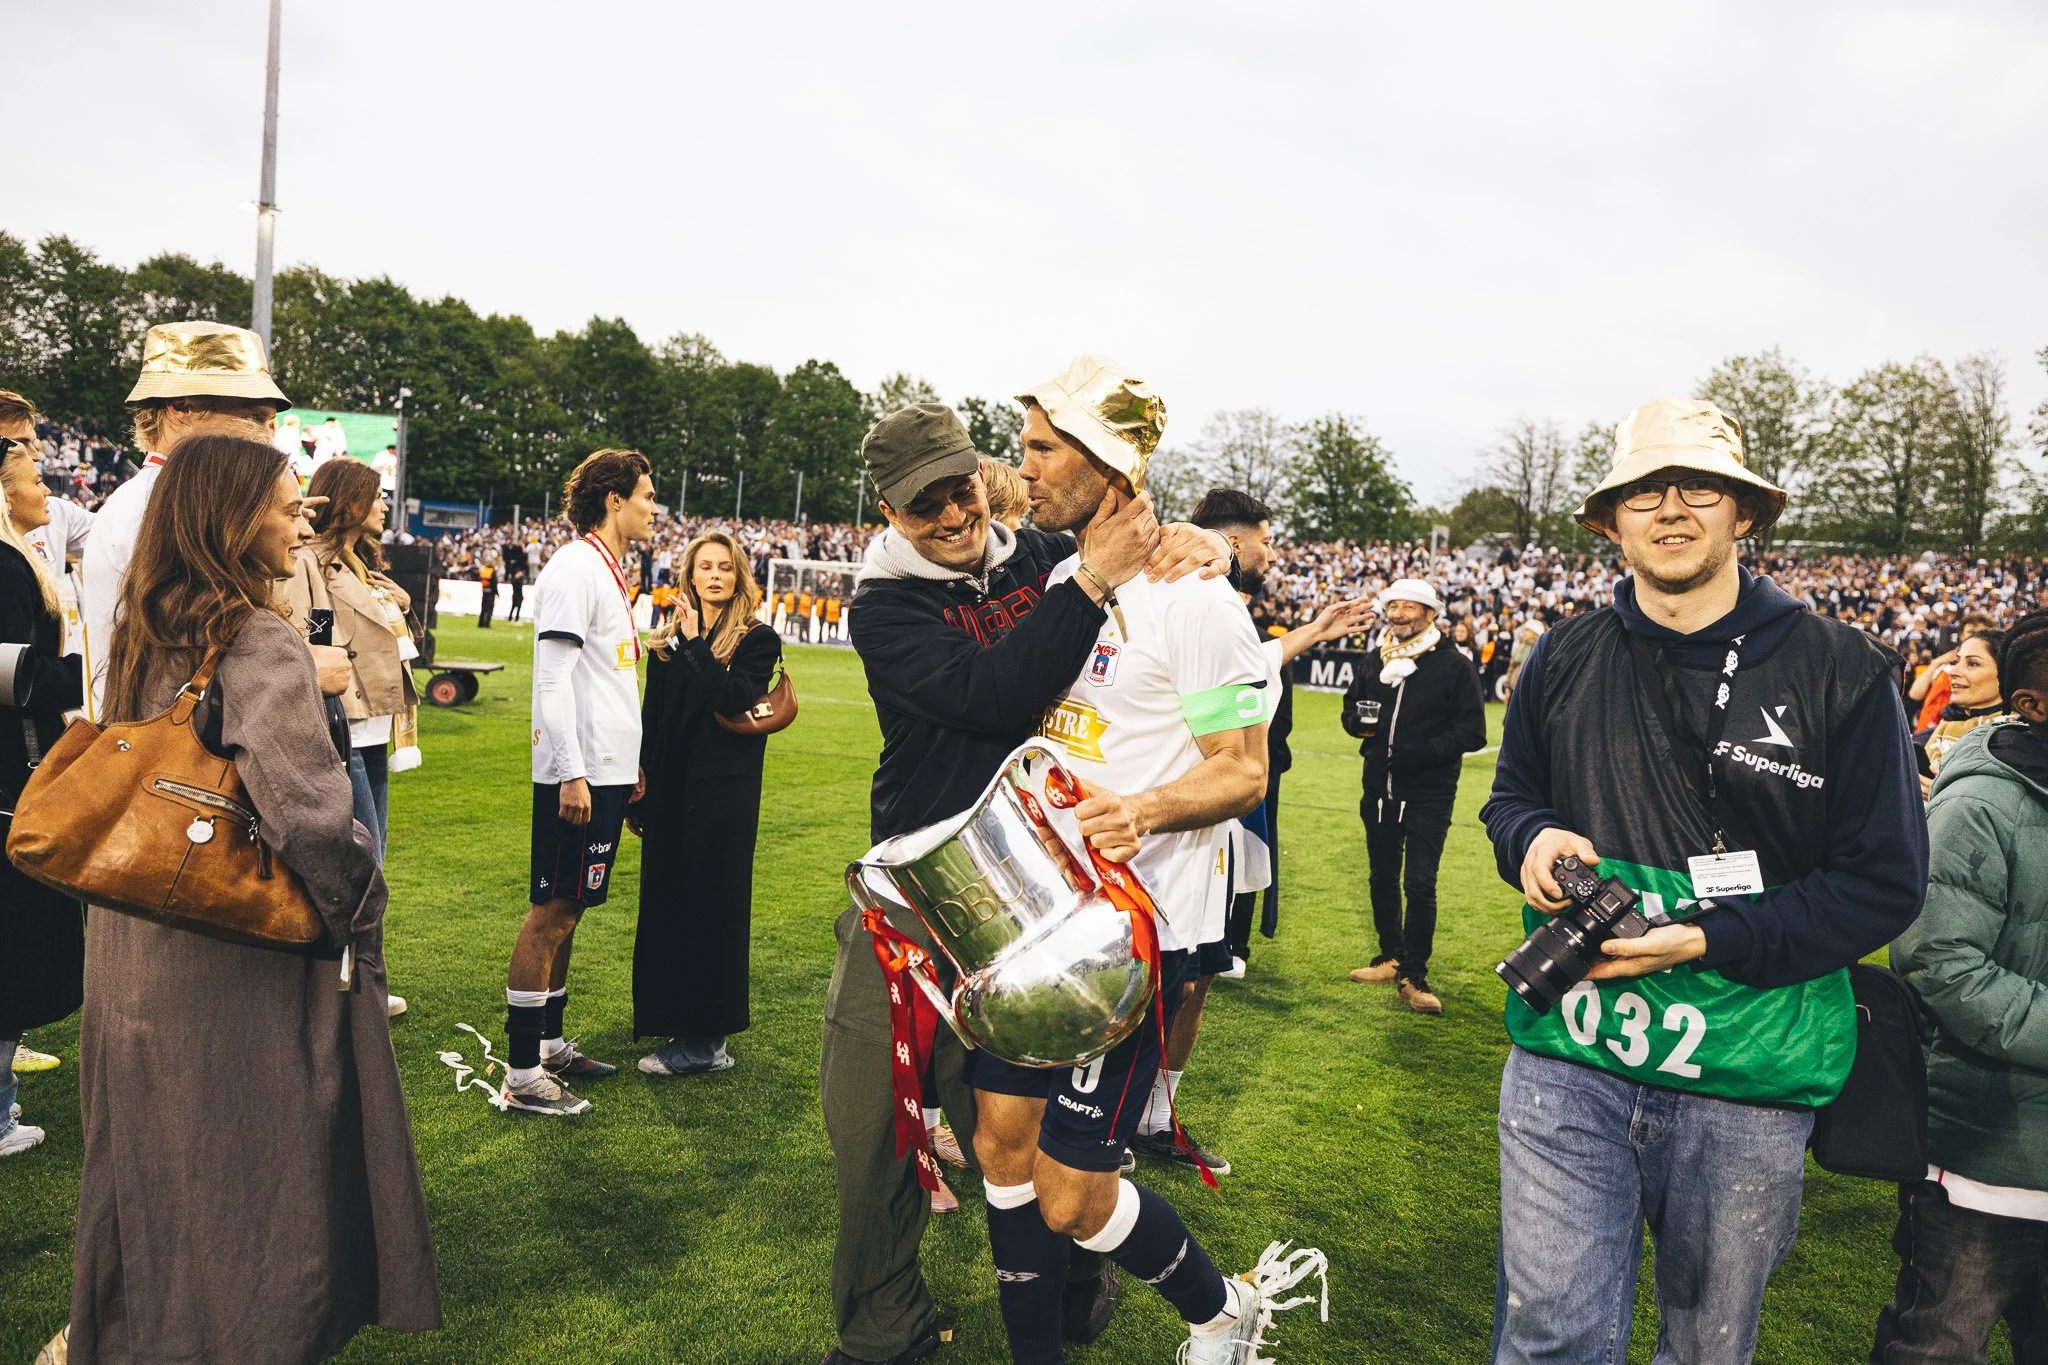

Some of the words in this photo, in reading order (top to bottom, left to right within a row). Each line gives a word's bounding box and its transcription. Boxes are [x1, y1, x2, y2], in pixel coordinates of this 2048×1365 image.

[1235, 688, 1262, 719] C
[1731, 745, 1825, 789] Superliga
[930, 855, 1024, 938] DBU
[1715, 884, 1752, 893] Superliga
[1561, 980, 1707, 1079] 032
[1058, 1094, 1094, 1115] CRAFT
